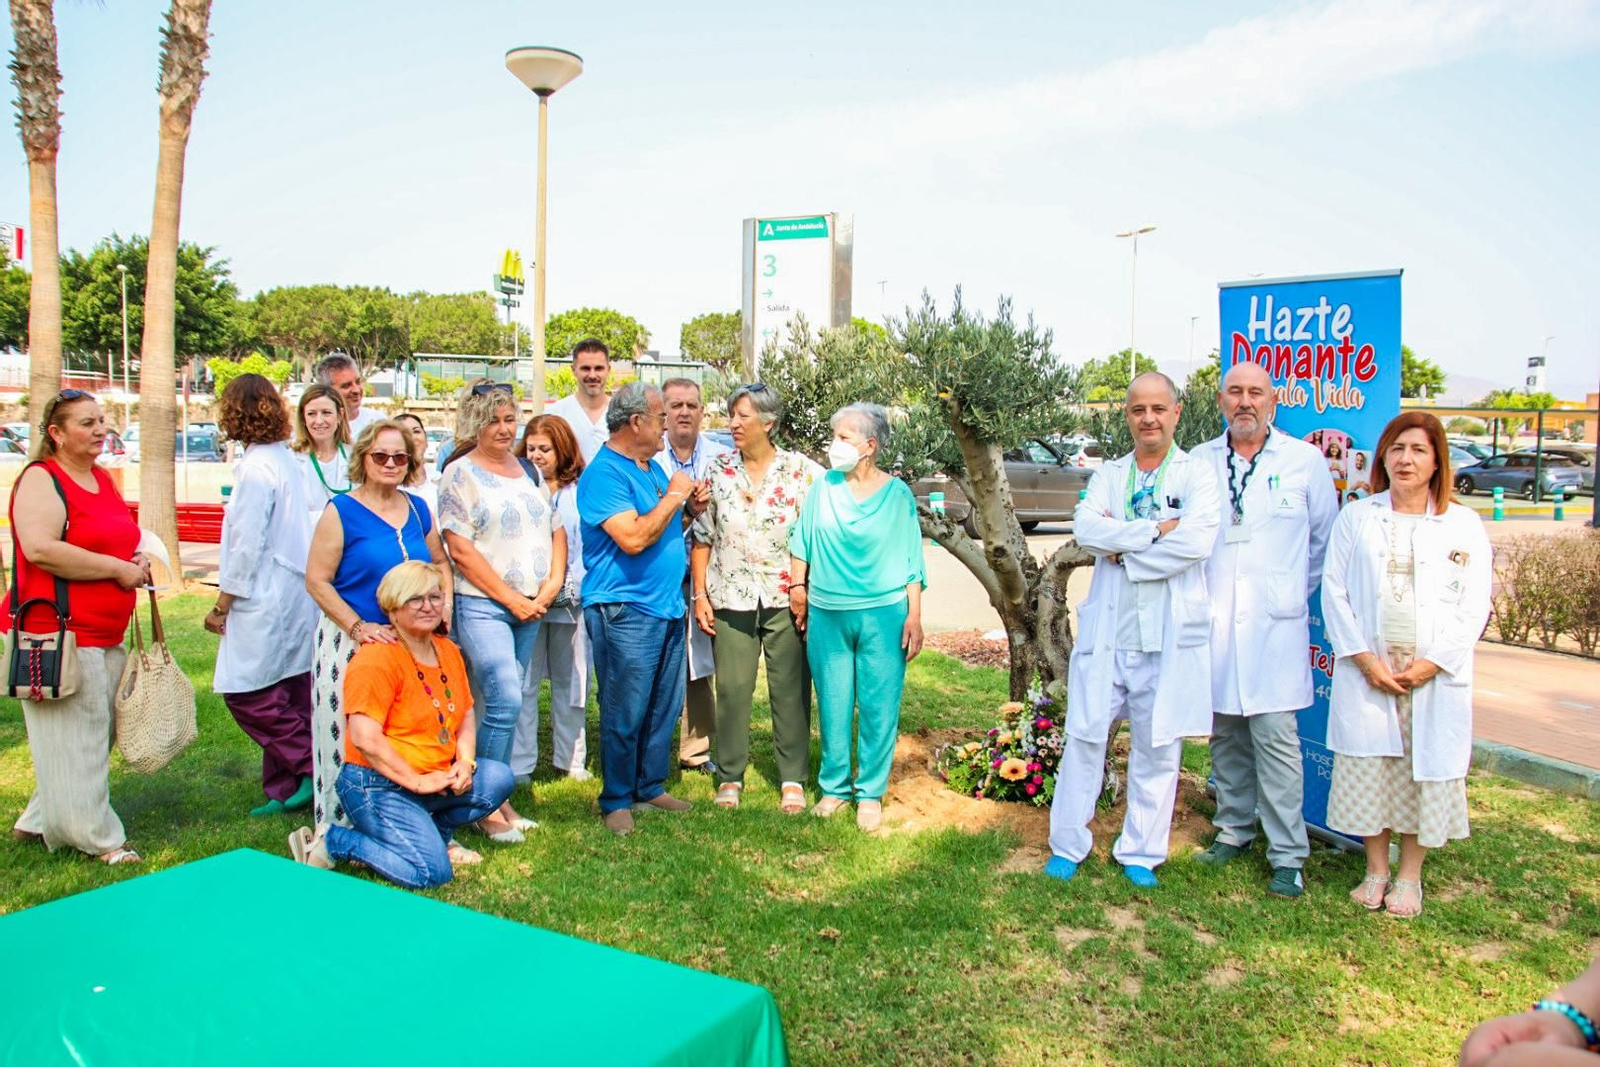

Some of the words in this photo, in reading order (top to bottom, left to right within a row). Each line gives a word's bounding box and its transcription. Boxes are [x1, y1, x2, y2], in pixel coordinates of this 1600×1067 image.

[763, 254, 776, 277] 3
[1248, 294, 1353, 342] Hazte
[1311, 373, 1365, 413] Vida
[1309, 645, 1335, 678] Tej
[1306, 747, 1334, 768] Hosp
[1317, 765, 1331, 780] Po
